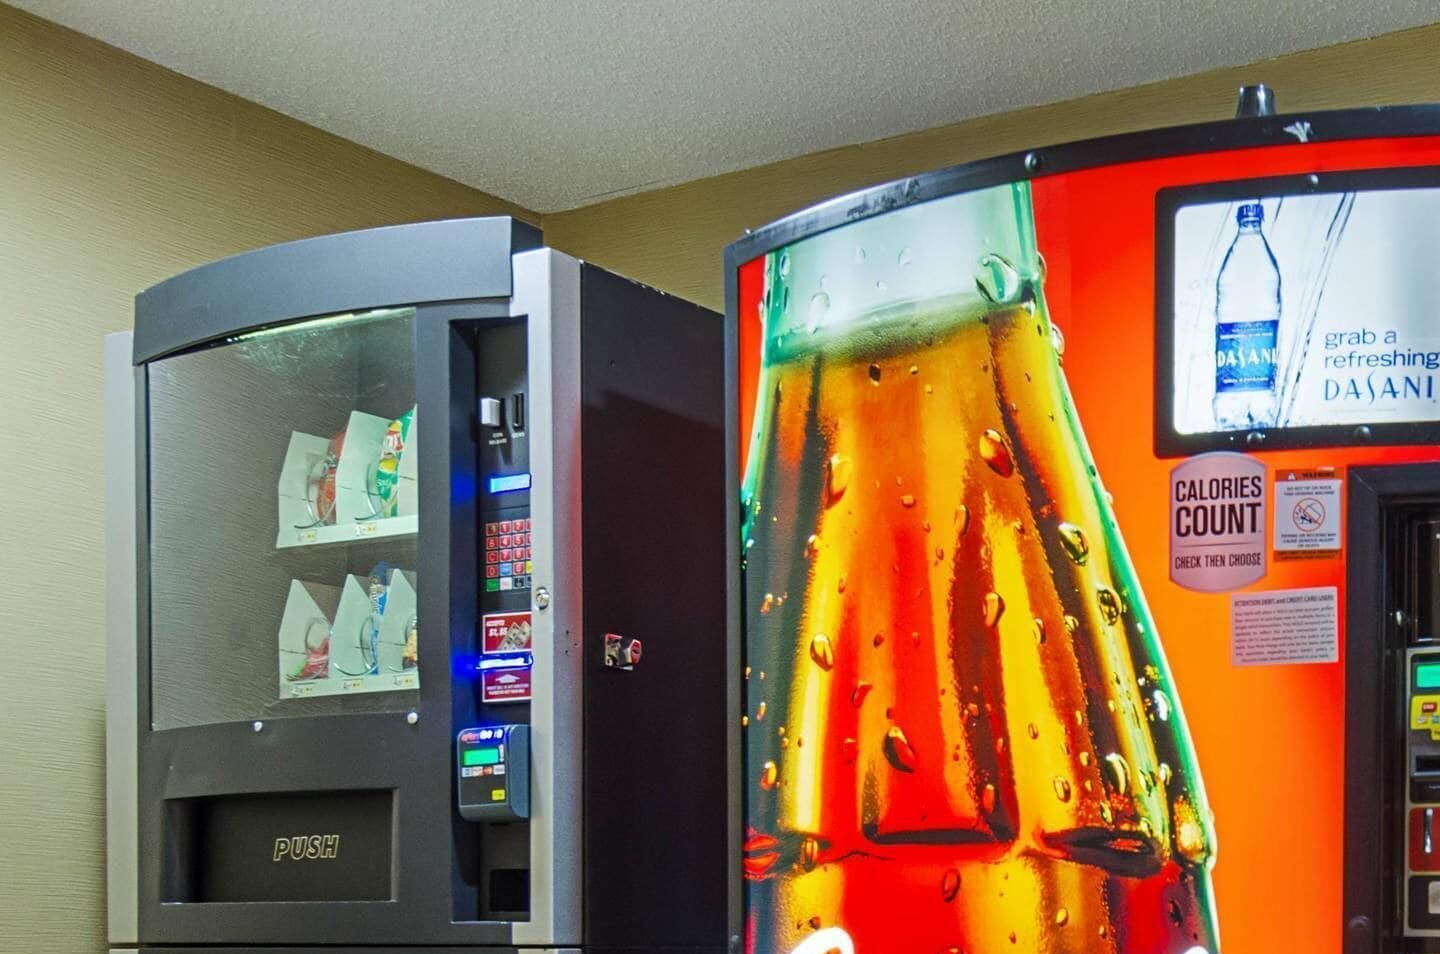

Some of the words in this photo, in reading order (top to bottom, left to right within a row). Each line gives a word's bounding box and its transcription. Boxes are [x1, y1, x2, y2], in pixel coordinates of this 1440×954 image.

[1324, 328, 1377, 350] grab
[1383, 330, 1397, 345] a
[1217, 347, 1277, 368] DASANI
[1323, 348, 1440, 369] refreshing
[1324, 371, 1433, 405] DASANI
[1175, 475, 1262, 502] CALORIES
[1175, 502, 1262, 538] COUNT
[1174, 556, 1202, 570] CHECK
[1204, 554, 1226, 568] THEN
[1228, 552, 1262, 567] CHOOSE
[273, 834, 340, 861] PUSH
